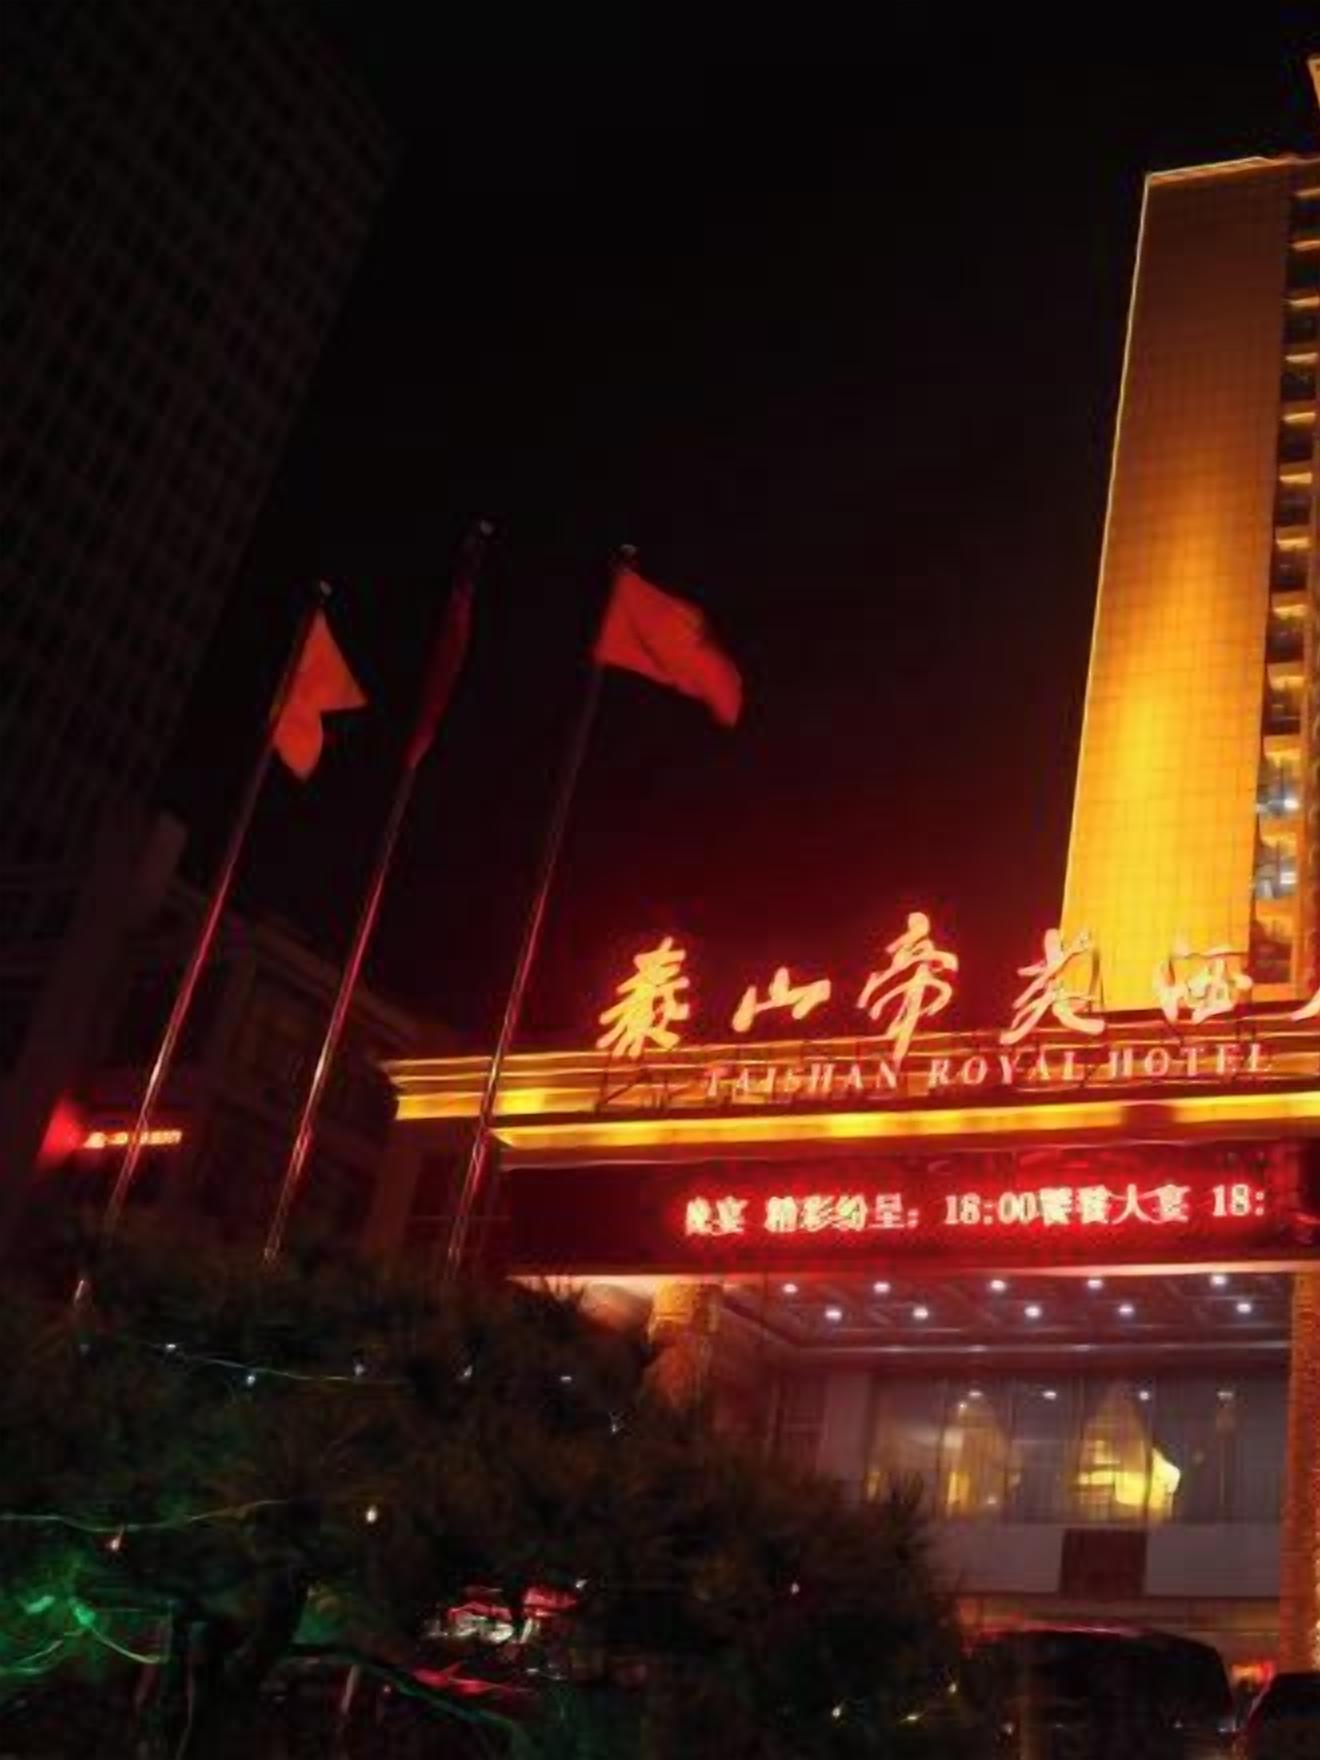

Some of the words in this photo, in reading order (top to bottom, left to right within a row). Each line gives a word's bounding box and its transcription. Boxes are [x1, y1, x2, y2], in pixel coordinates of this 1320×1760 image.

[705, 1058, 898, 1097] TAISHAN
[927, 1050, 1085, 1087] ROYAL
[1109, 1043, 1273, 1078] HOTEL
